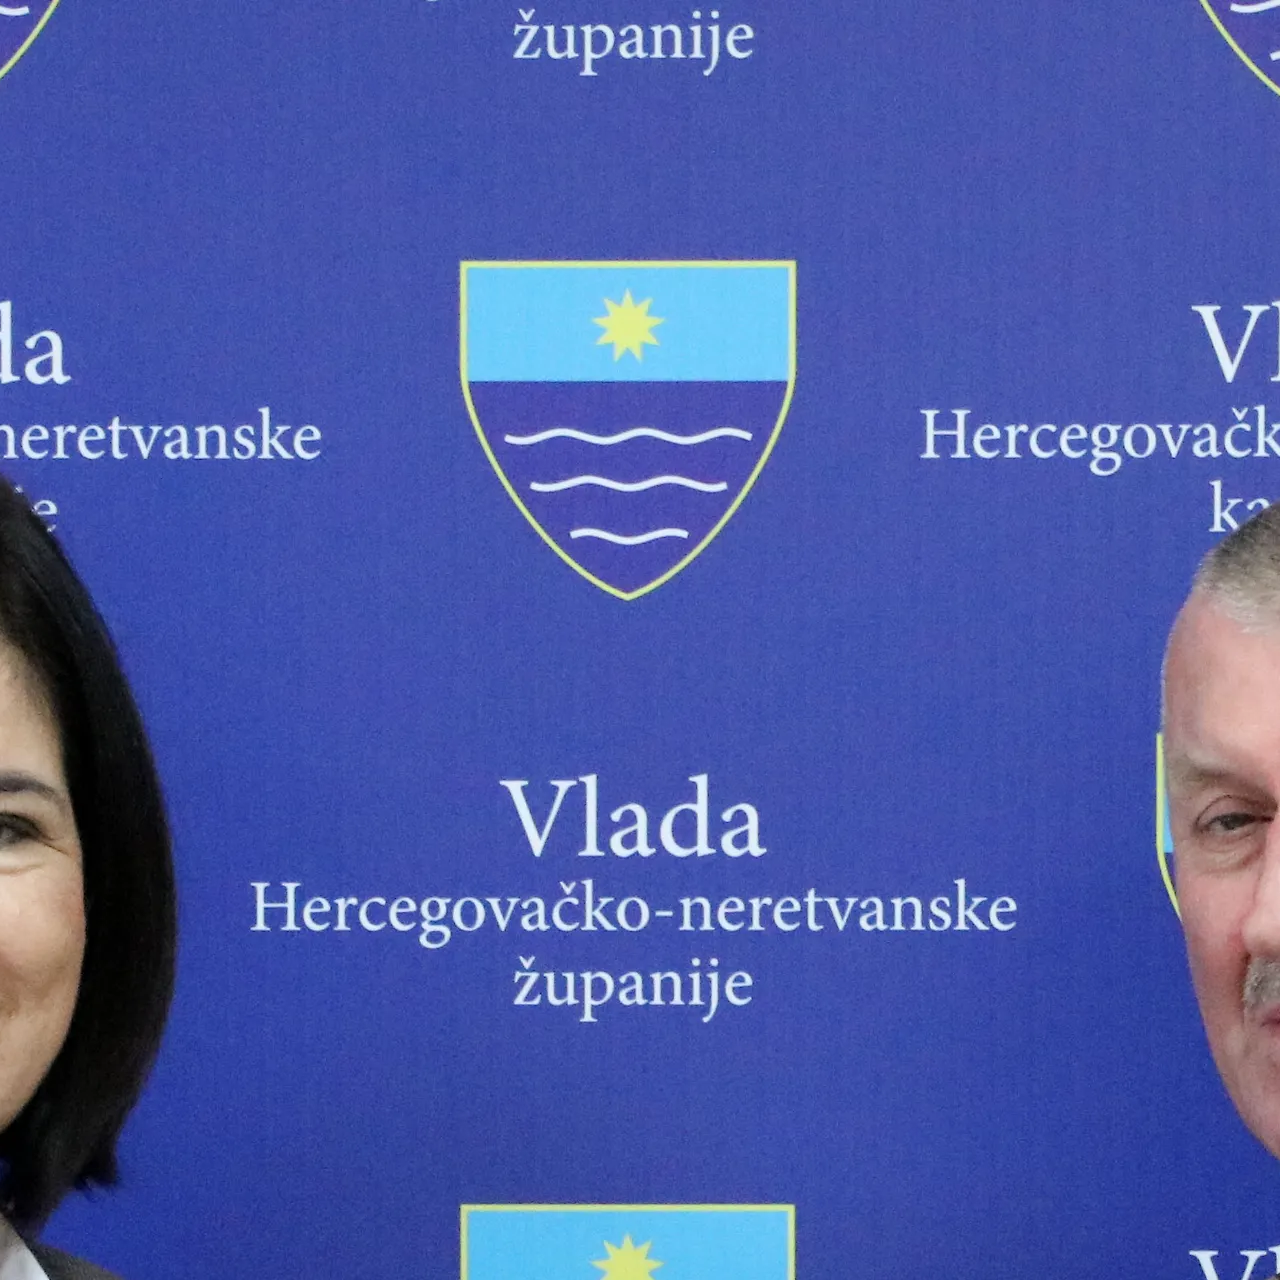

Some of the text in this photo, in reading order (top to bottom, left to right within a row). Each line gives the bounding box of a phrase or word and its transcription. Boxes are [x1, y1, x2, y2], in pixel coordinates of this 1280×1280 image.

[513, 7, 755, 77] županije
[499, 773, 768, 858] Vlada
[250, 878, 1018, 949] Hercegovačko-neretvanske
[513, 955, 753, 1023] županije
